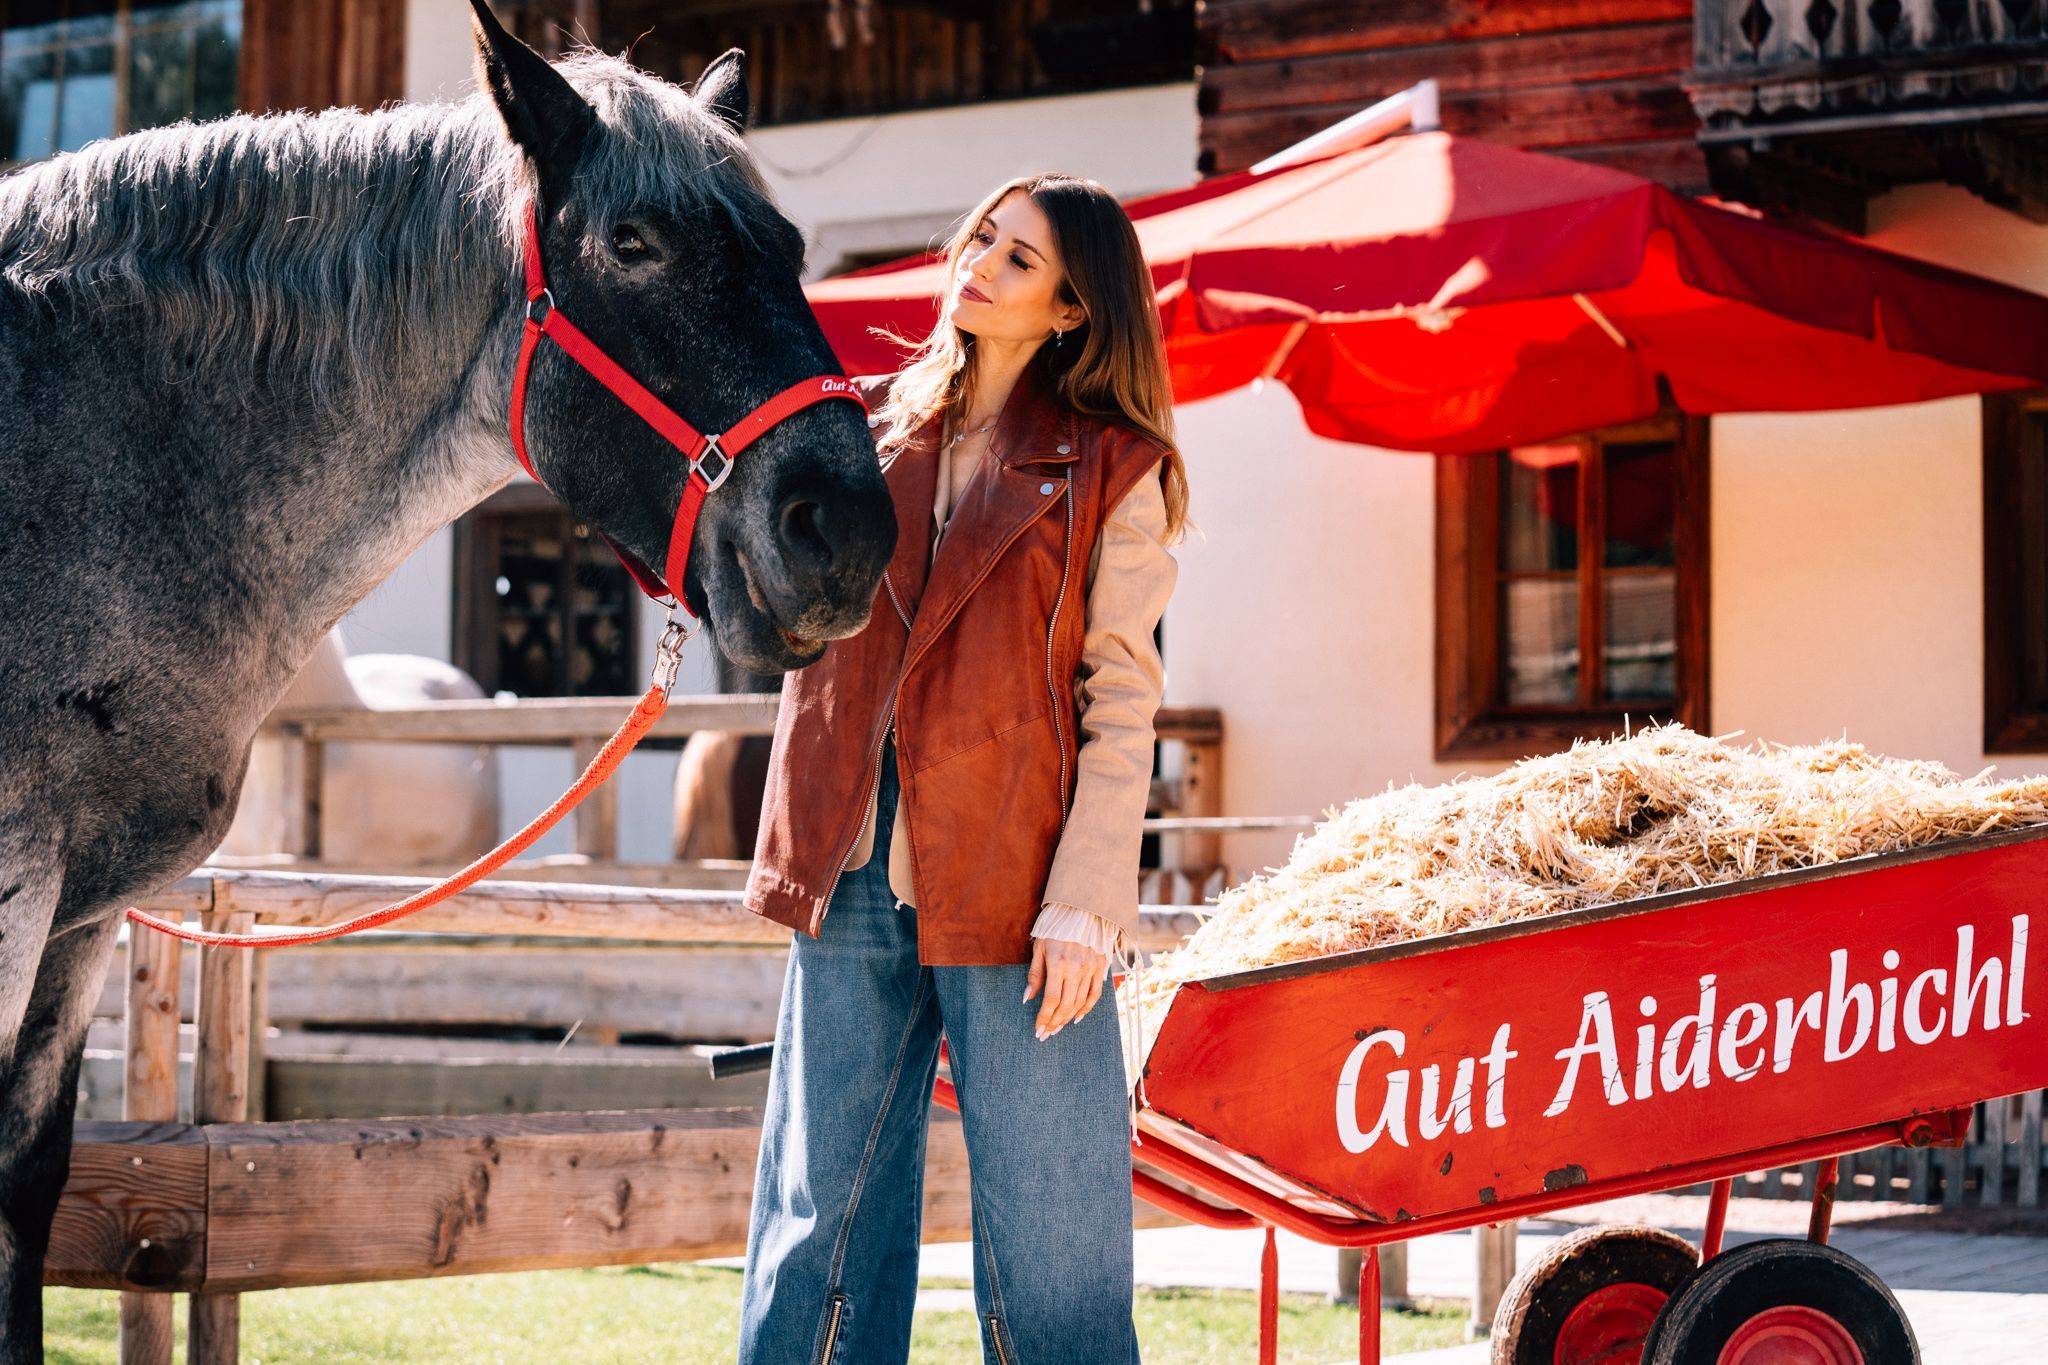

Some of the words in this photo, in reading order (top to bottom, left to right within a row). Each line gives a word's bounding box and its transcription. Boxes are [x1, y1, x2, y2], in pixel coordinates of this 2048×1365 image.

[821, 378, 847, 392] Gut
[1335, 1023, 1518, 1154] Gut
[1542, 913, 2031, 1118] Aiderbichl
